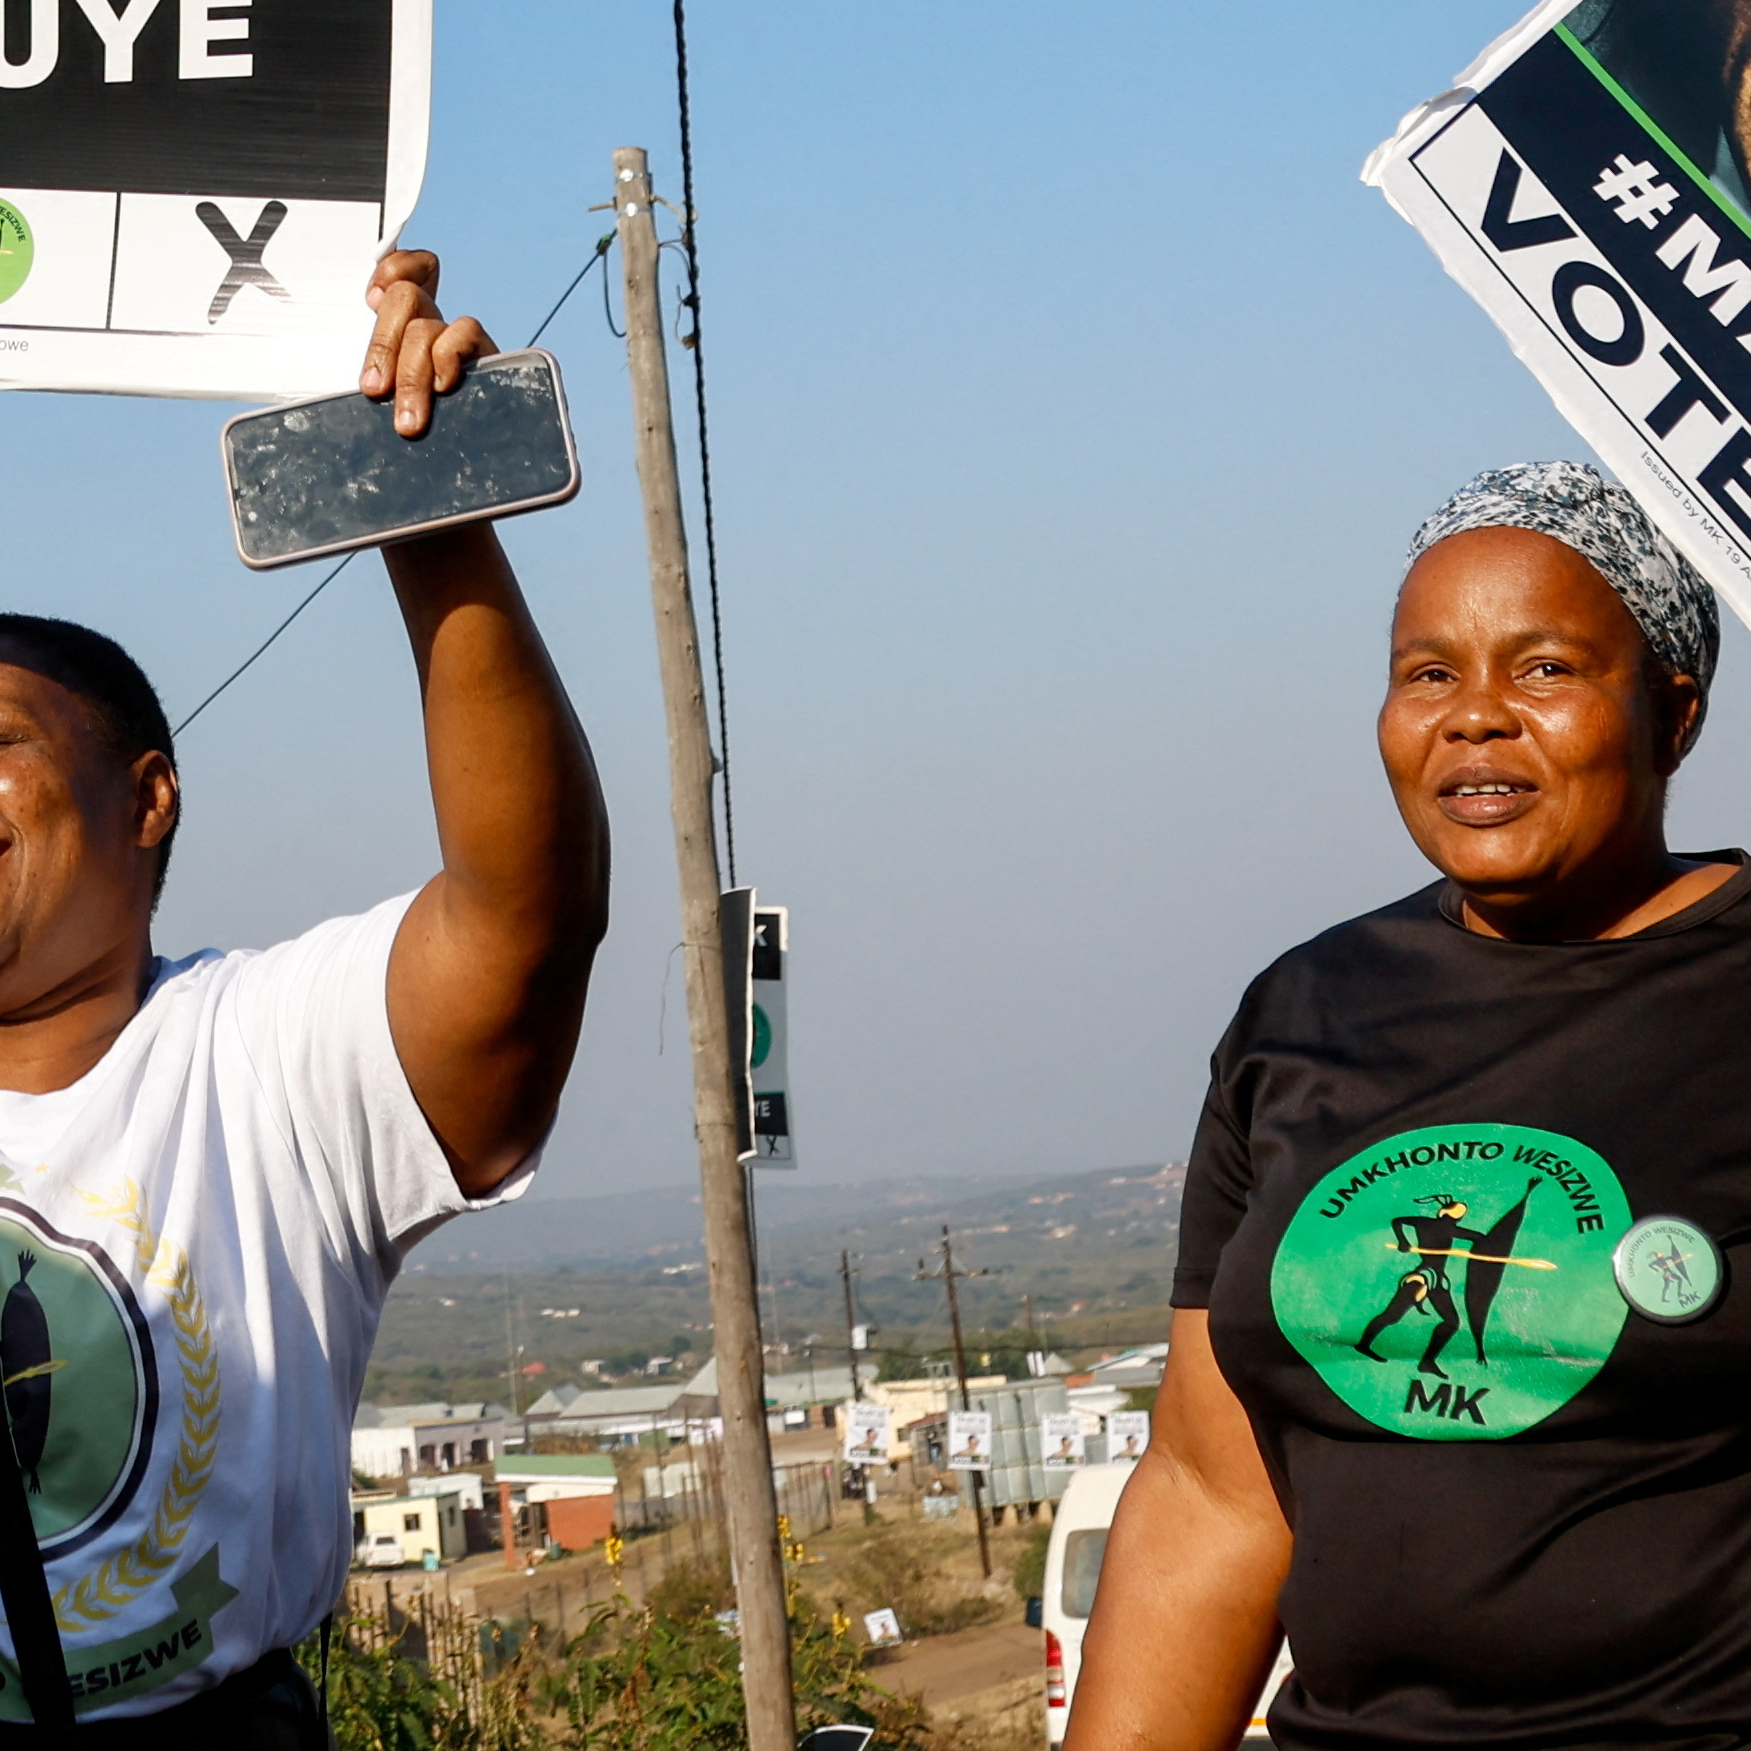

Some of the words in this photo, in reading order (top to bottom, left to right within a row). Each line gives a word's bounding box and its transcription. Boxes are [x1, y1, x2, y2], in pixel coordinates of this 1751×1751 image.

[1641, 450, 1684, 498] Issued
[1683, 496, 1700, 517] by
[1700, 518, 1724, 545] MK
[1725, 545, 1742, 565] 19
[1319, 1140, 1505, 1220] UMKHONTO
[1513, 1144, 1605, 1235] WESIZWE
[1678, 1291, 1701, 1309] MK
[1403, 1379, 1491, 1426] MK
[68, 1619, 202, 1697] ESIZWE
